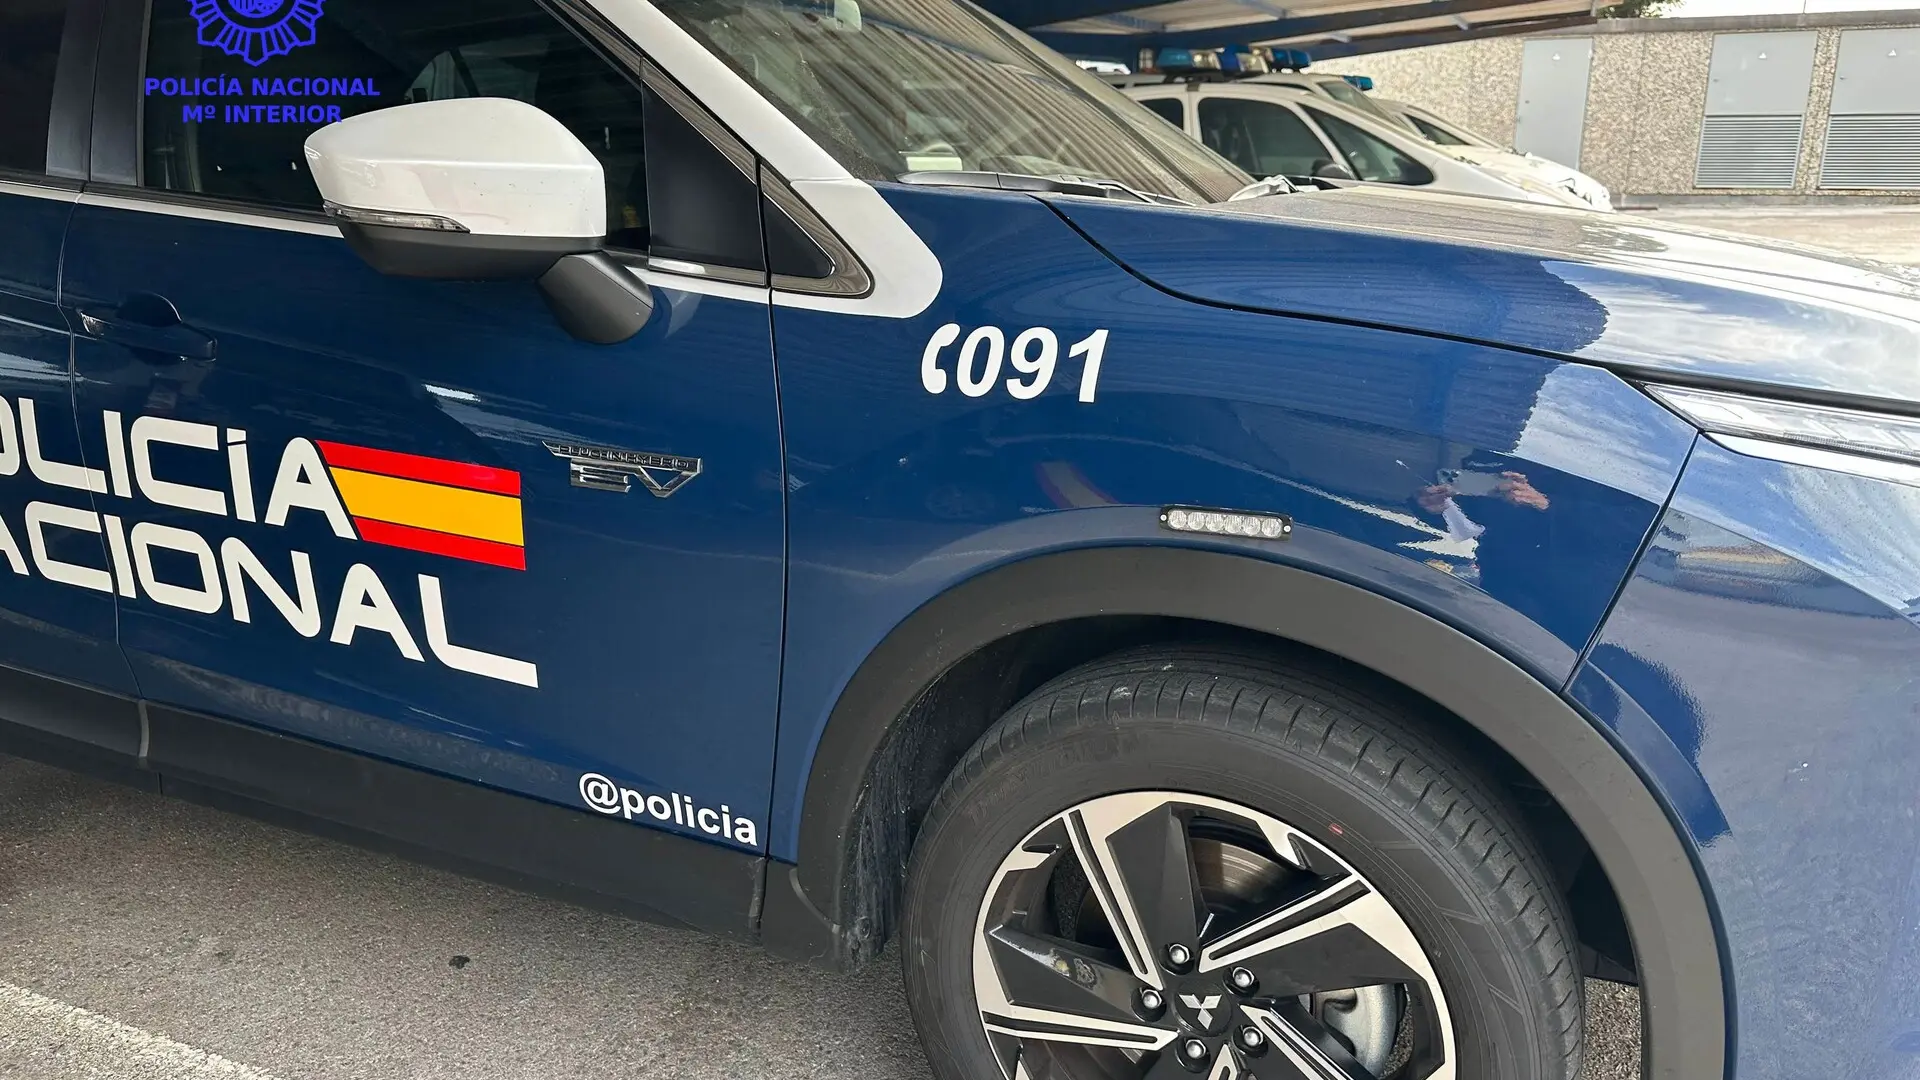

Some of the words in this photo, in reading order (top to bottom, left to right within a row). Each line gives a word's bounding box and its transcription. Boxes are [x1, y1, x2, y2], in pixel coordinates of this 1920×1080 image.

[956, 325, 1109, 403] 091
[0, 395, 358, 540] LICÍA
[578, 772, 758, 847] @policia
